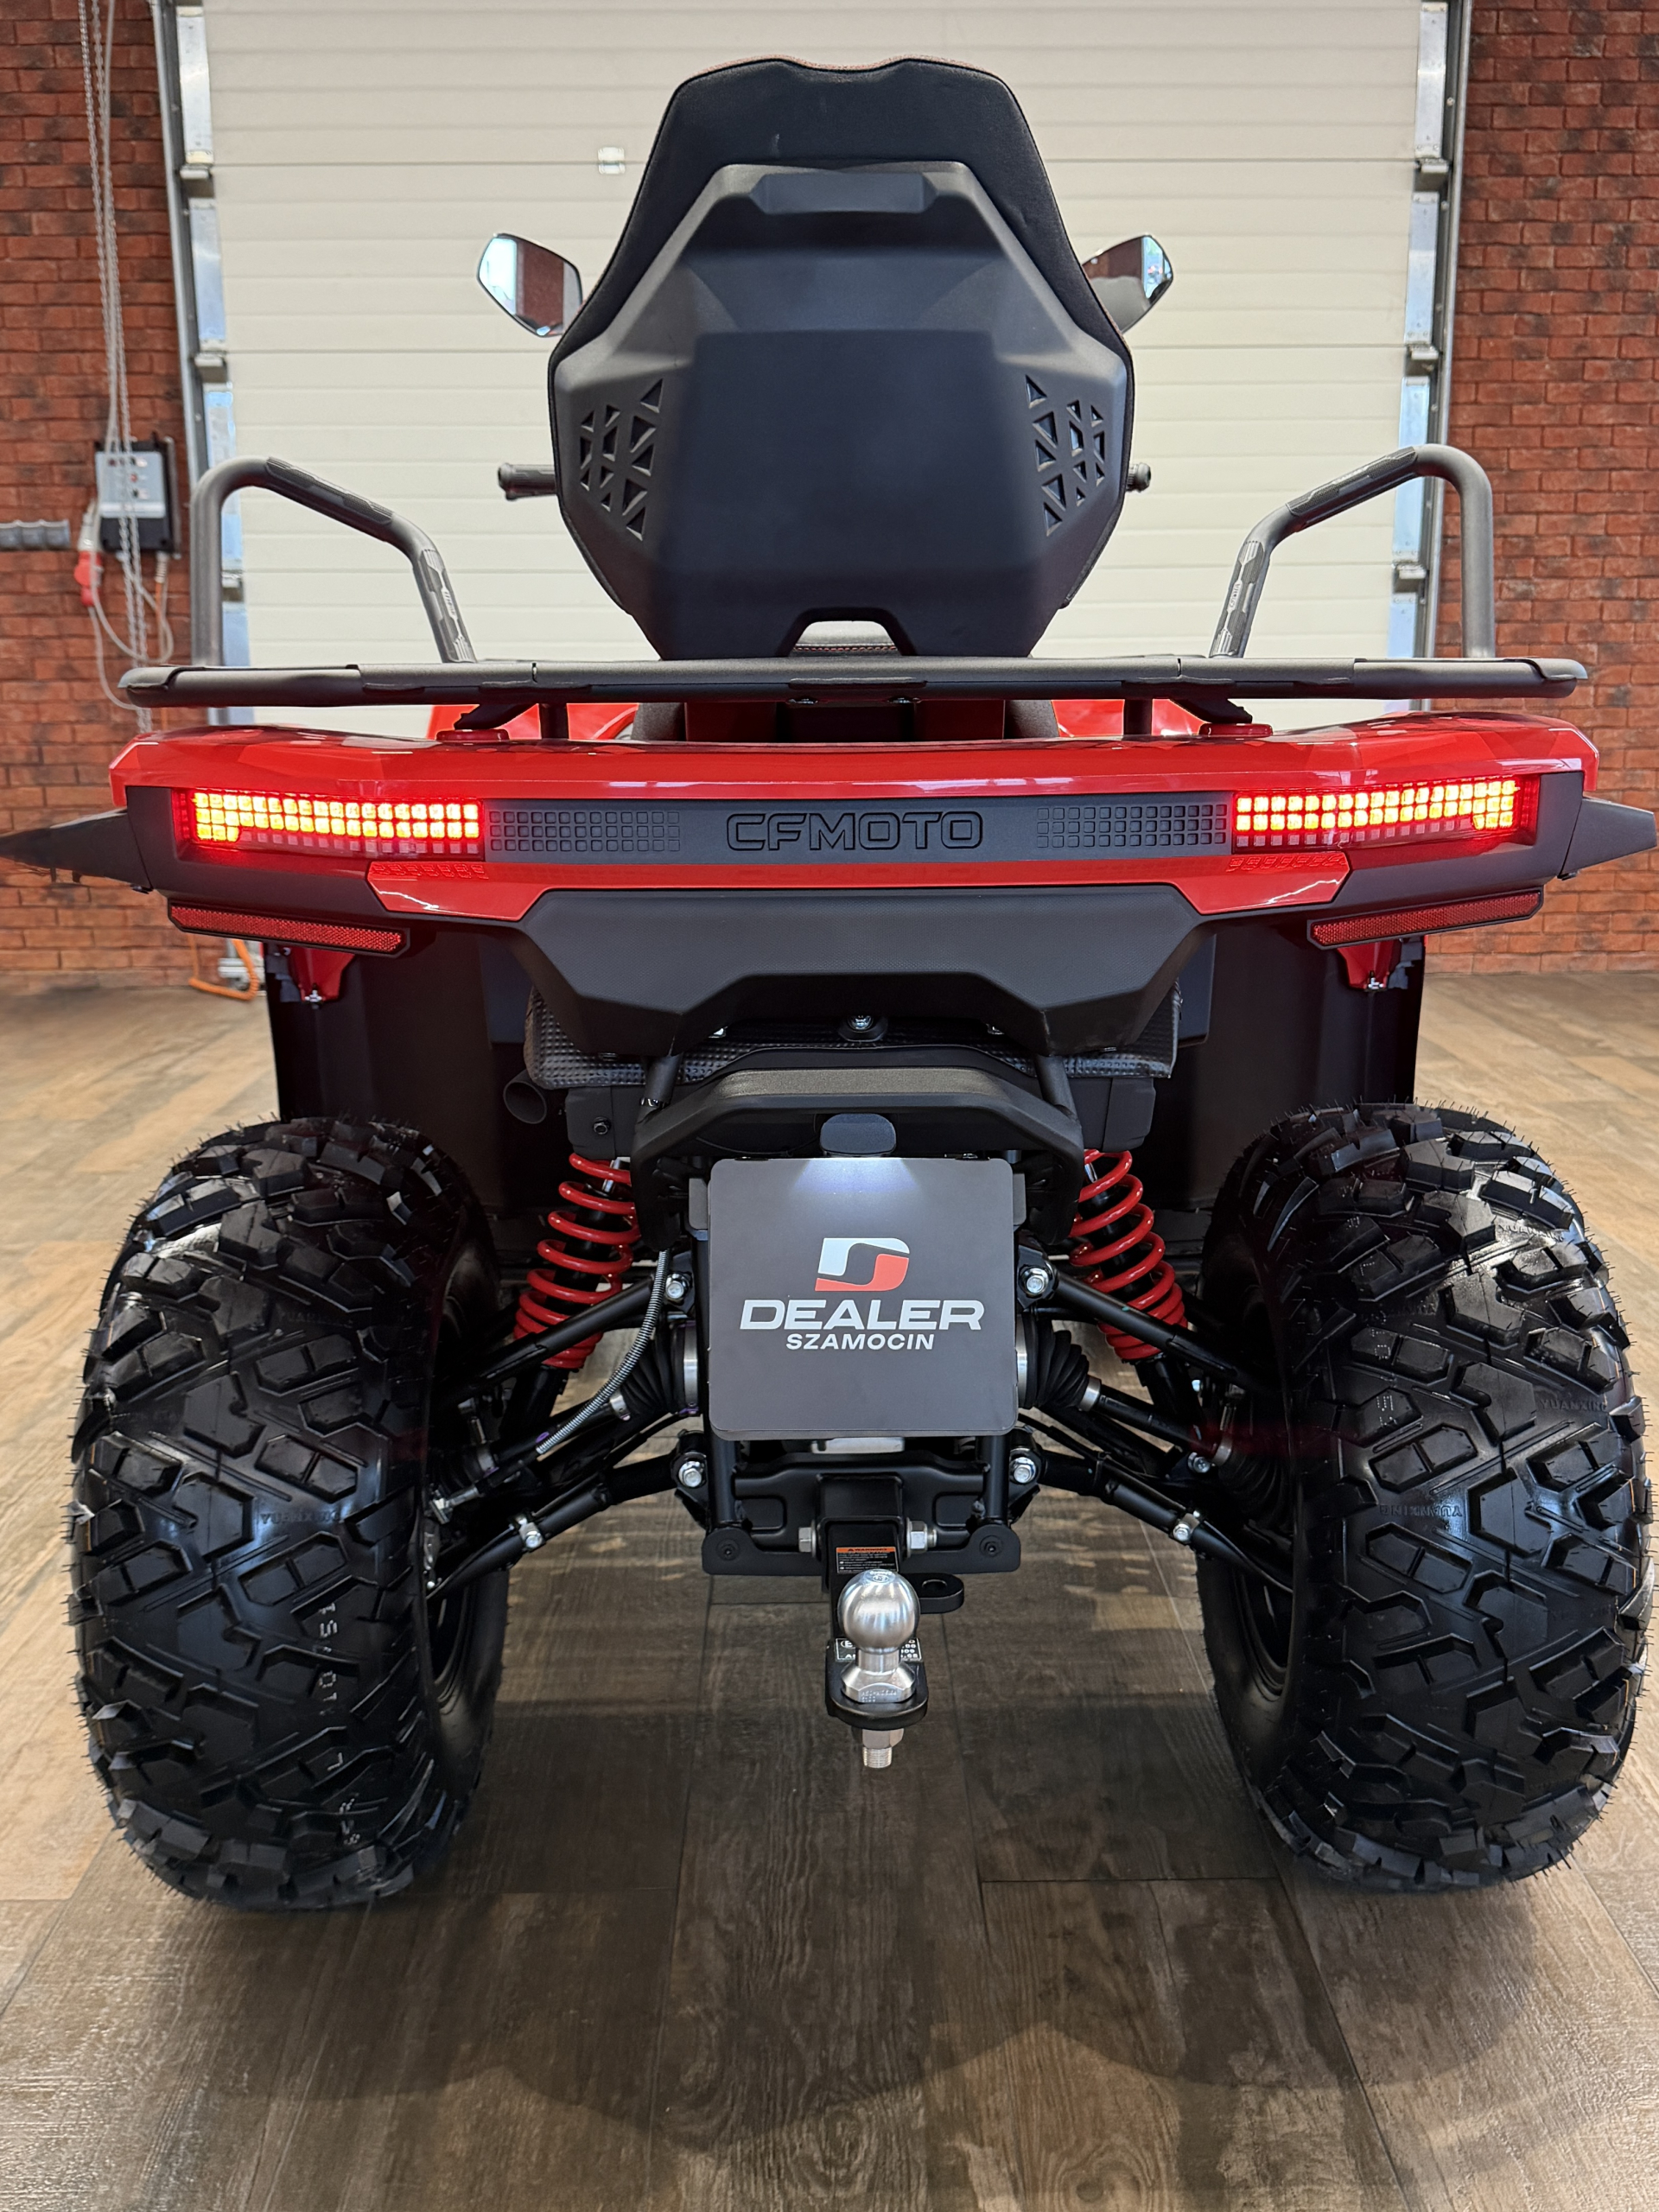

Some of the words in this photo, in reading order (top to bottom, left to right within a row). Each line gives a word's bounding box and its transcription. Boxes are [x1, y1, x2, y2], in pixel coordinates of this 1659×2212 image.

[727, 810, 983, 851] CFMOTO
[740, 1299, 985, 1331] DEALER
[785, 1333, 935, 1350] SZAMOCIN
